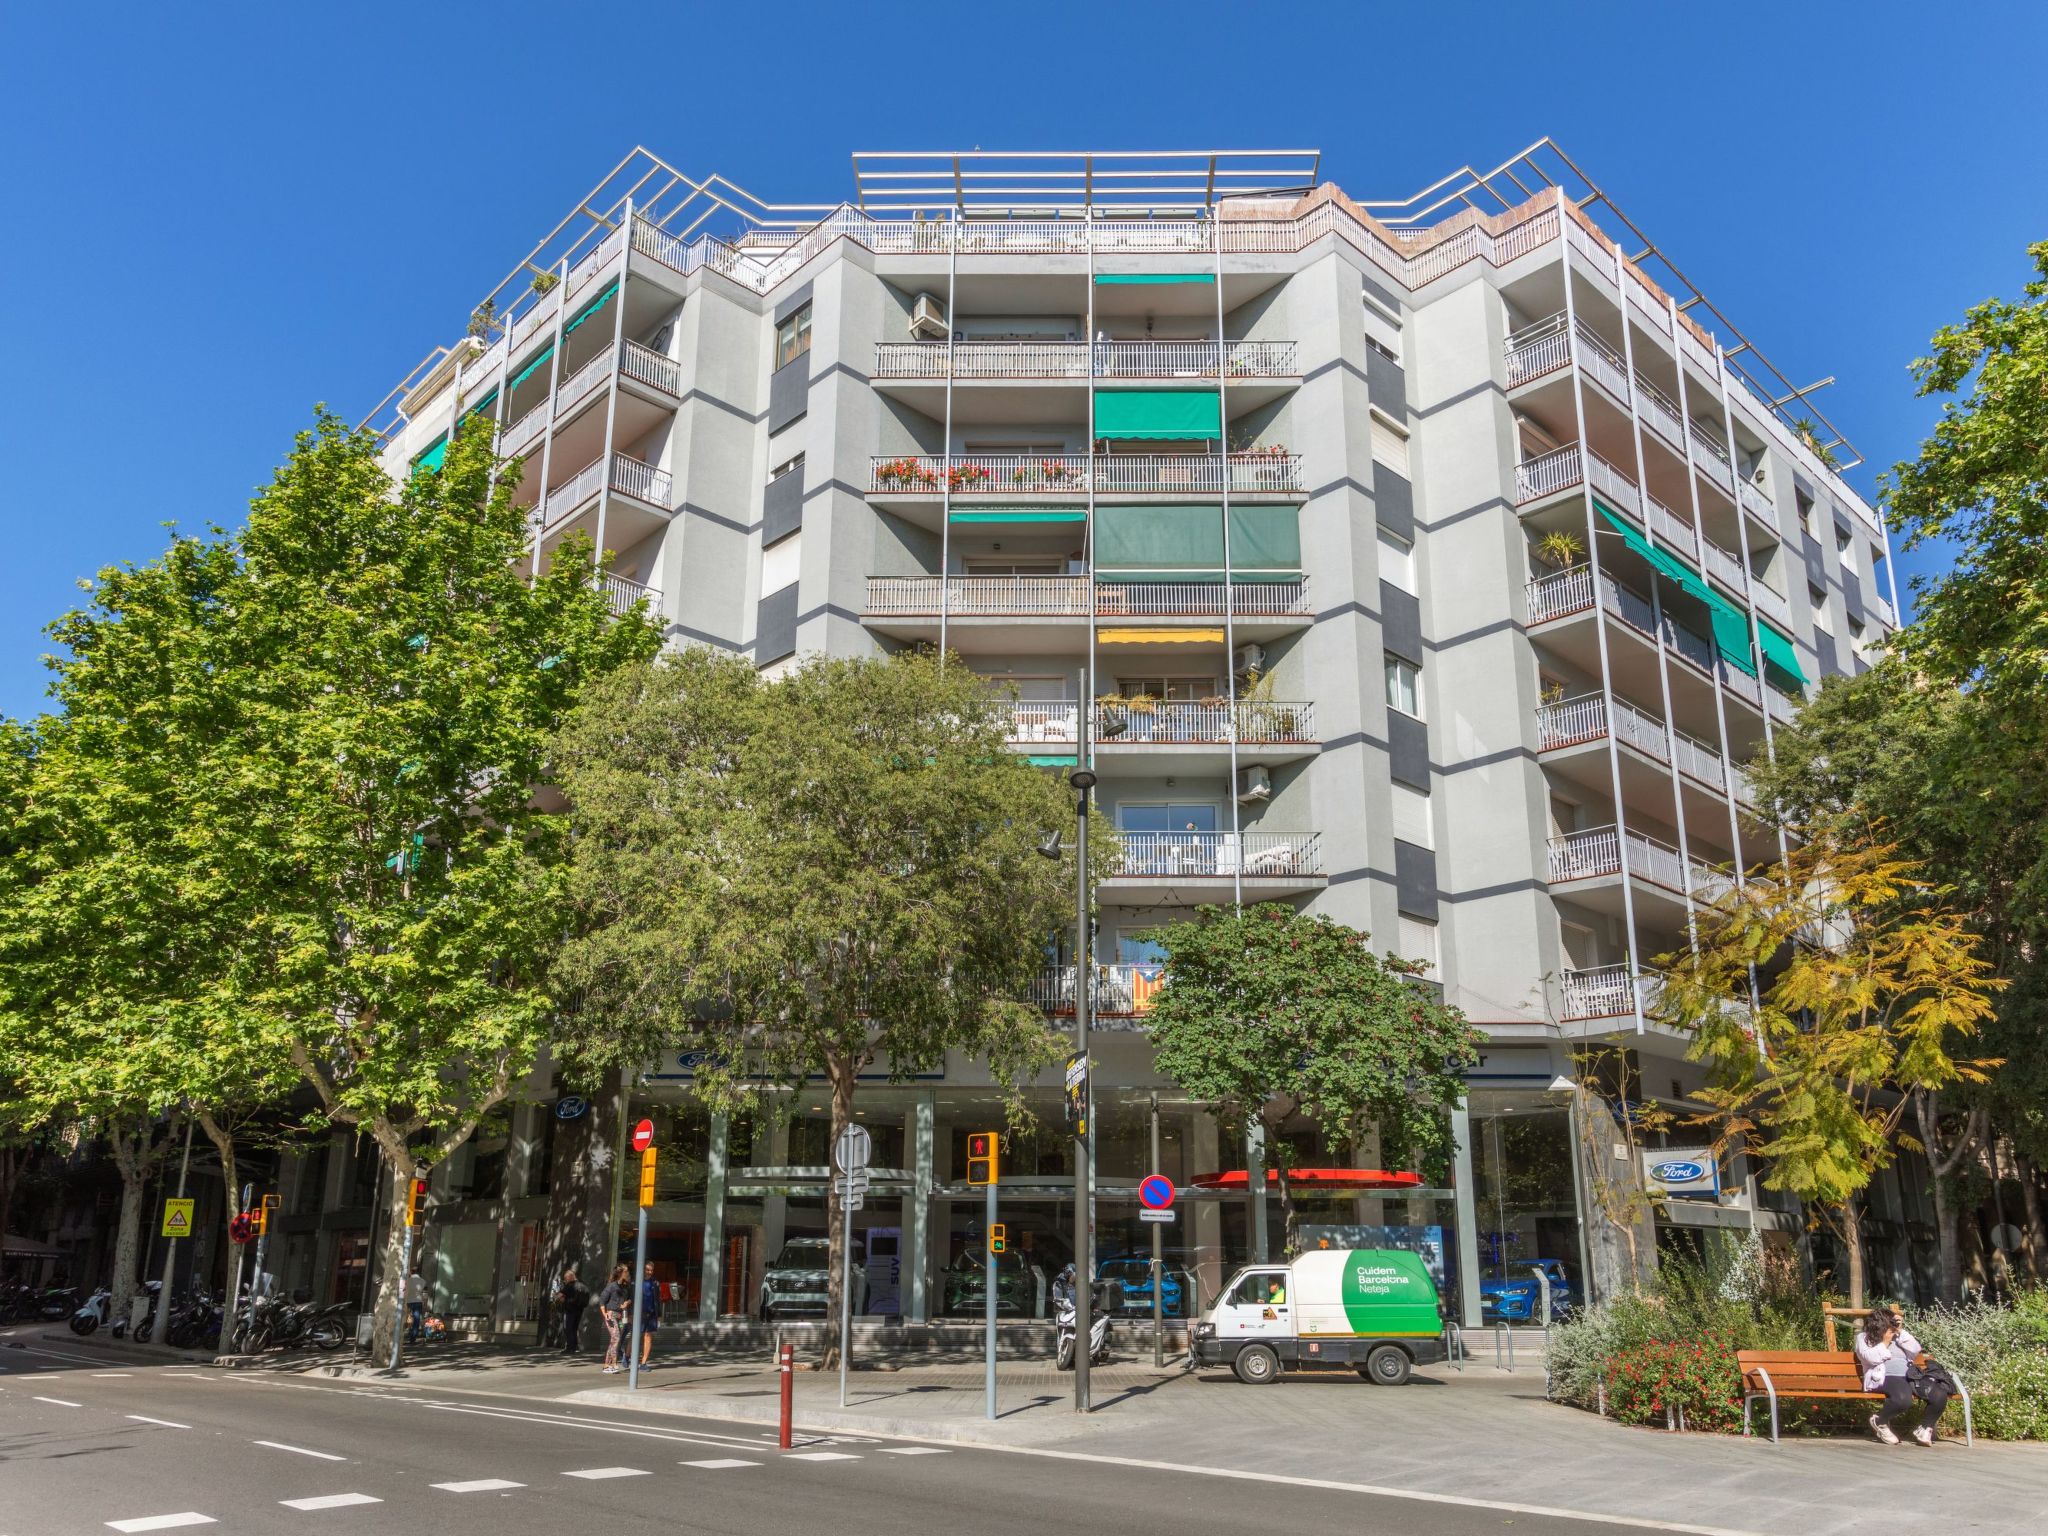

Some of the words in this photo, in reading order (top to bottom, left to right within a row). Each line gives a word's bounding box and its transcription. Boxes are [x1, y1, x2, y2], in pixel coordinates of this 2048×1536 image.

[1661, 1163, 1693, 1178] Ford
[890, 1257, 900, 1286] SUV
[1356, 1266, 1397, 1275] Cuidem
[1358, 1275, 1409, 1284] Barcelona
[1359, 1285, 1390, 1295] Neteja
